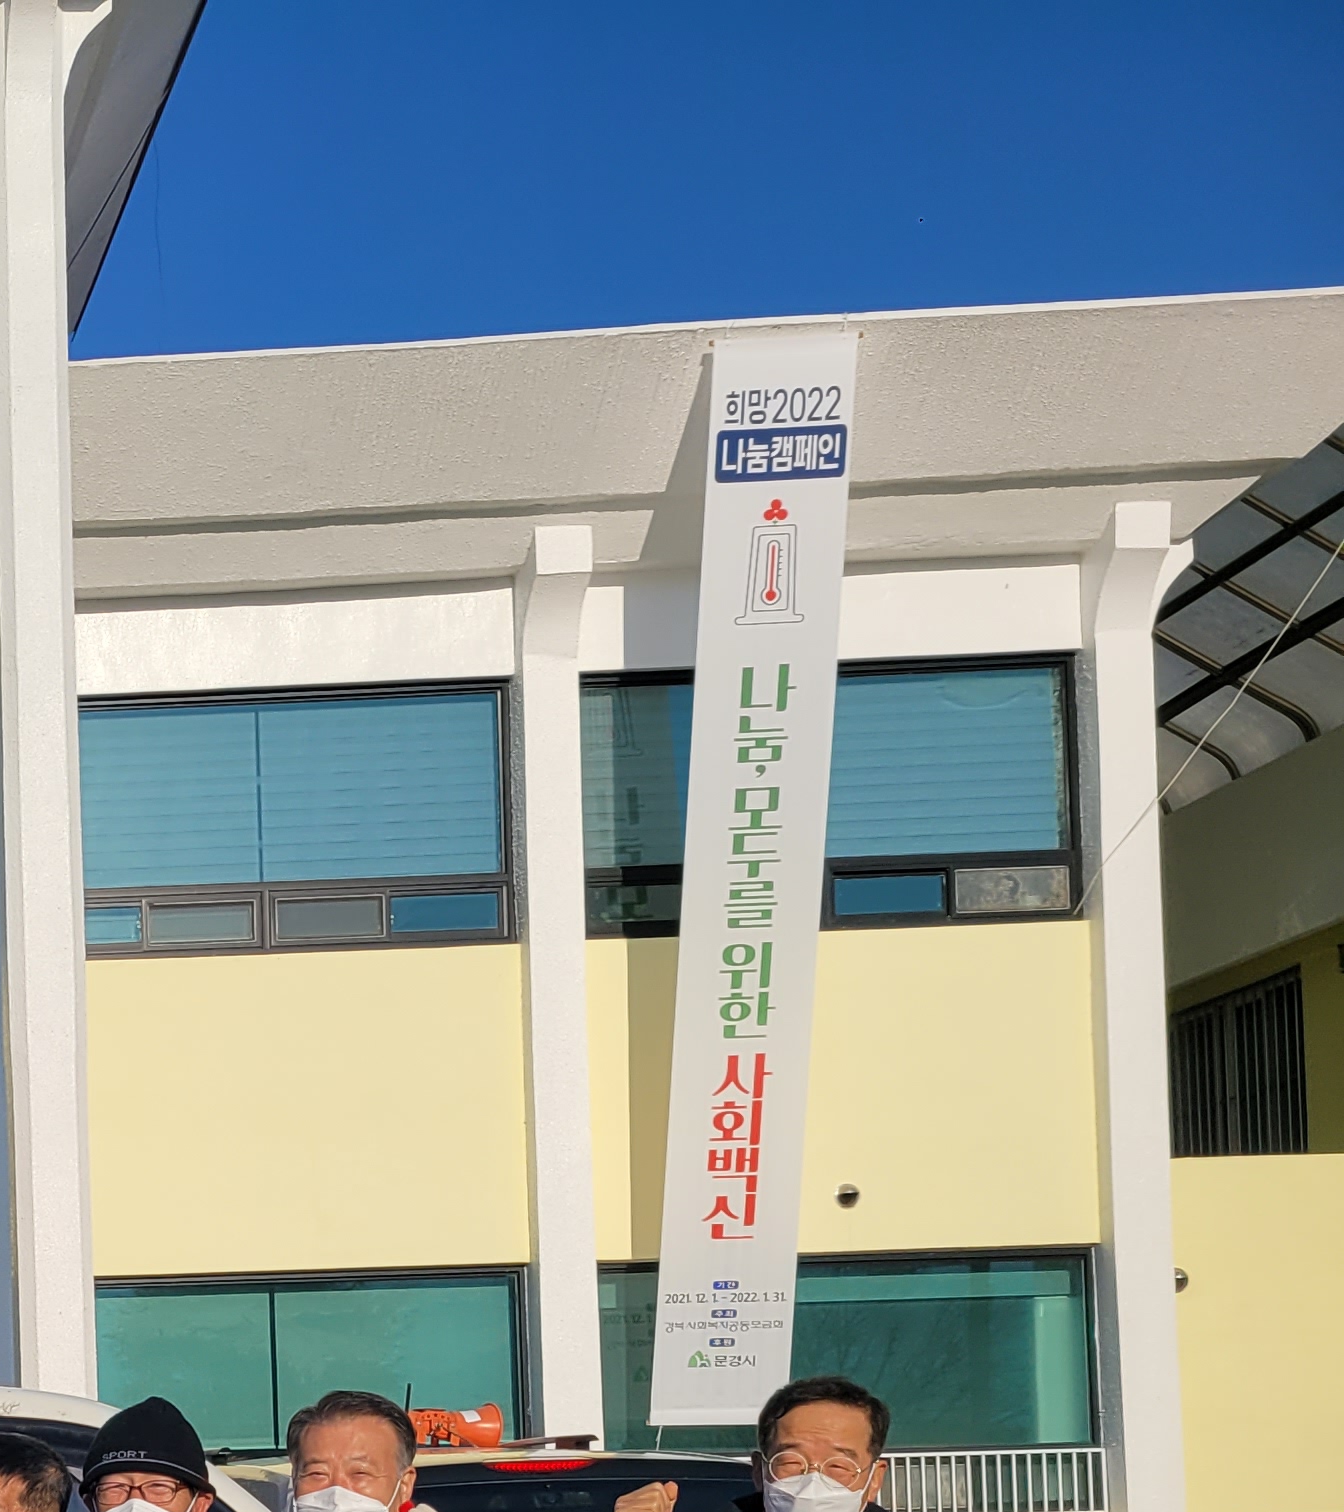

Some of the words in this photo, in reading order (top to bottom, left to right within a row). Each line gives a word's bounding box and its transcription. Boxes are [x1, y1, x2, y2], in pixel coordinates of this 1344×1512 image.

[724, 386, 841, 425] 희망2022
[721, 433, 841, 474] 나눔캠페인
[734, 663, 797, 778] 나눔,
[723, 786, 783, 930] 모두를
[719, 940, 776, 1039] 위한
[702, 1052, 773, 1240] 사회백신
[714, 1354, 756, 1367] 문경시
[102, 1450, 148, 1460] SPORT
